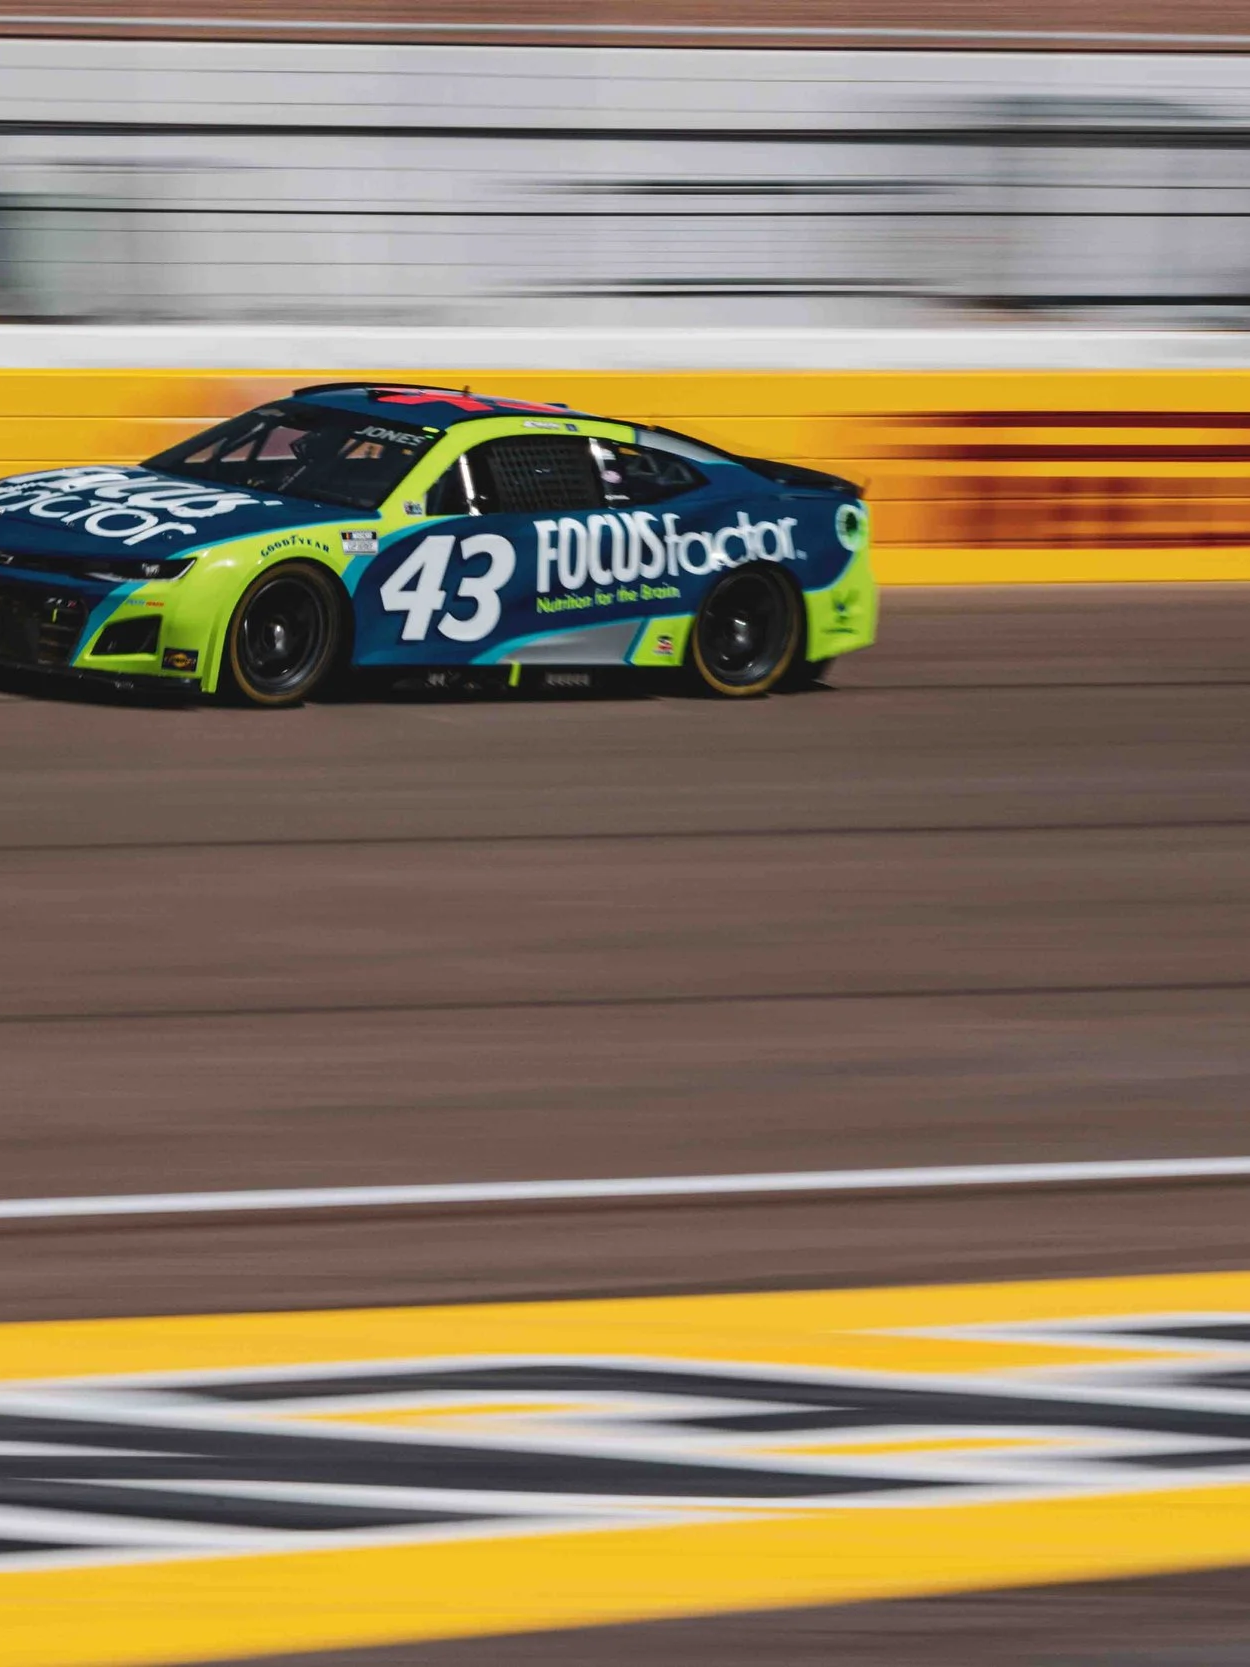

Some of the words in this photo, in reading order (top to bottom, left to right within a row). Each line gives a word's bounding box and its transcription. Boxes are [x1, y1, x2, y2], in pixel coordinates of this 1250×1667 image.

[354, 425, 427, 447] JONES
[260, 535, 330, 557] GOODYEAR
[380, 533, 517, 642] 43
[536, 593, 593, 613] Nutrition
[594, 588, 614, 606] for
[616, 584, 638, 601] the
[640, 582, 681, 600] Brain
